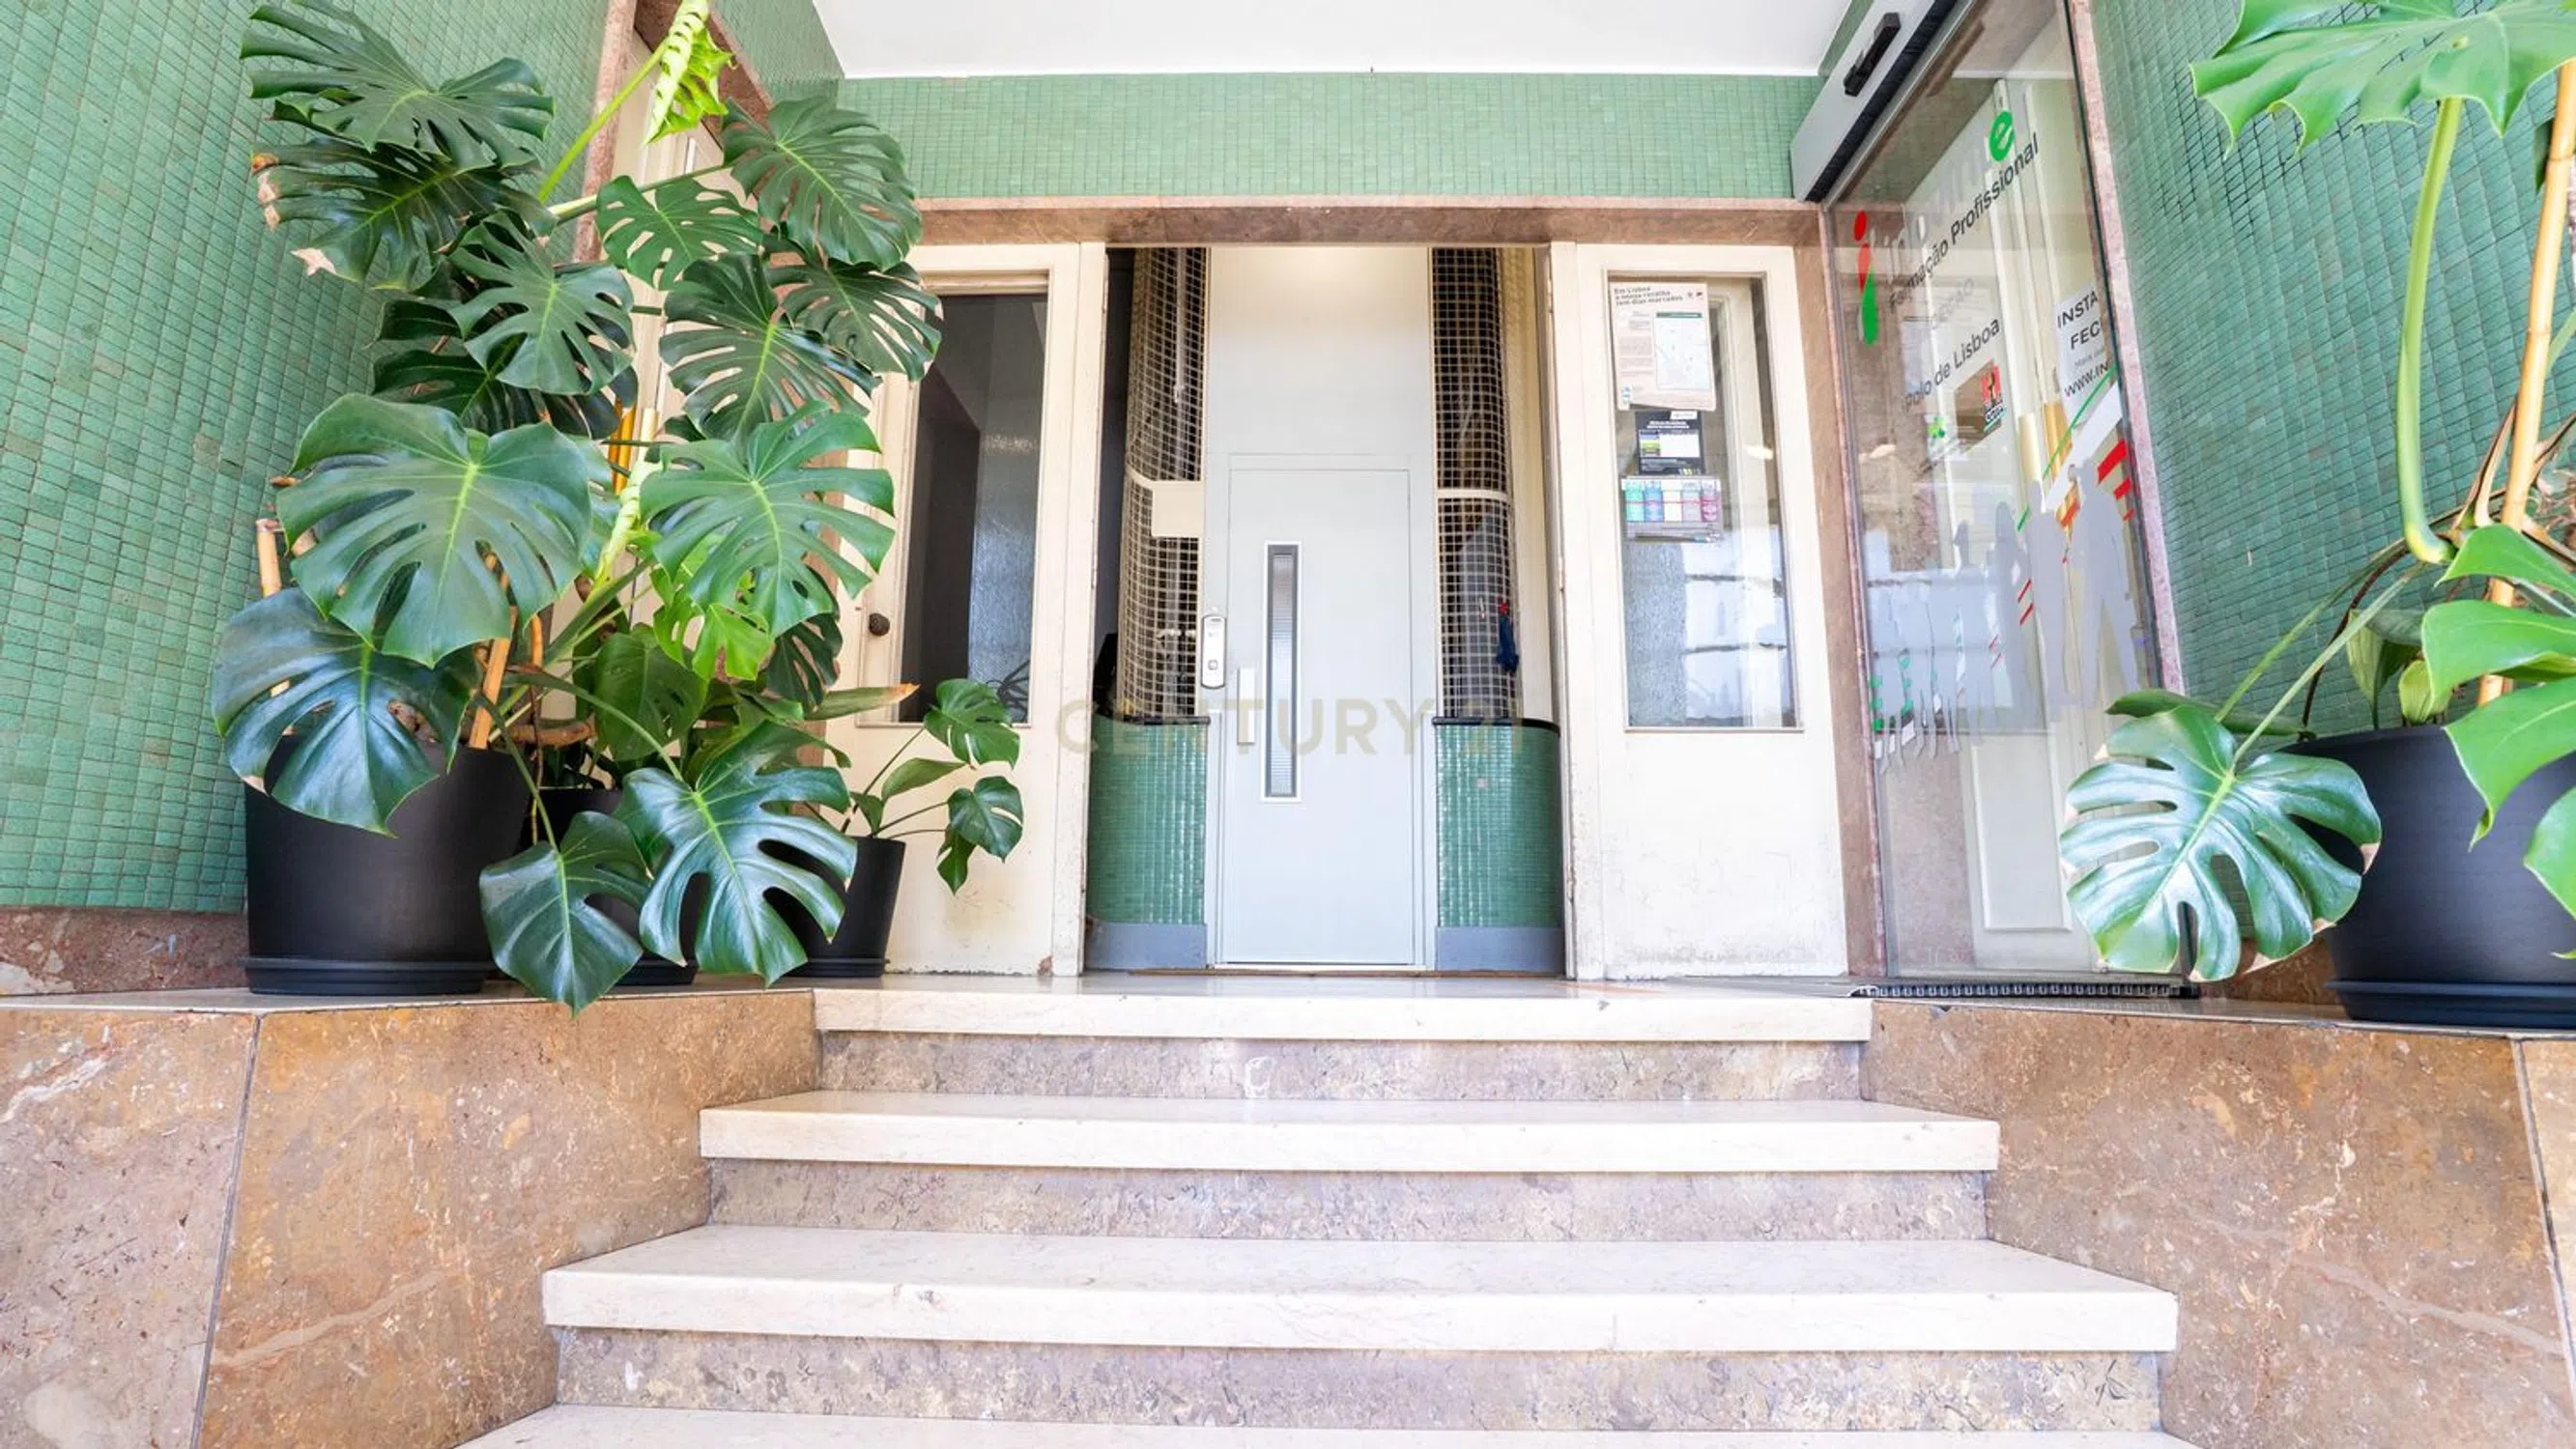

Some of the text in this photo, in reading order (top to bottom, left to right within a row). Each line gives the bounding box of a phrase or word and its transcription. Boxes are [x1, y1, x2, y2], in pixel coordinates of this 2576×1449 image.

[1949, 132, 2039, 246] Profissional
[1933, 360, 1952, 387] de
[1954, 317, 2001, 371] Lisboa
